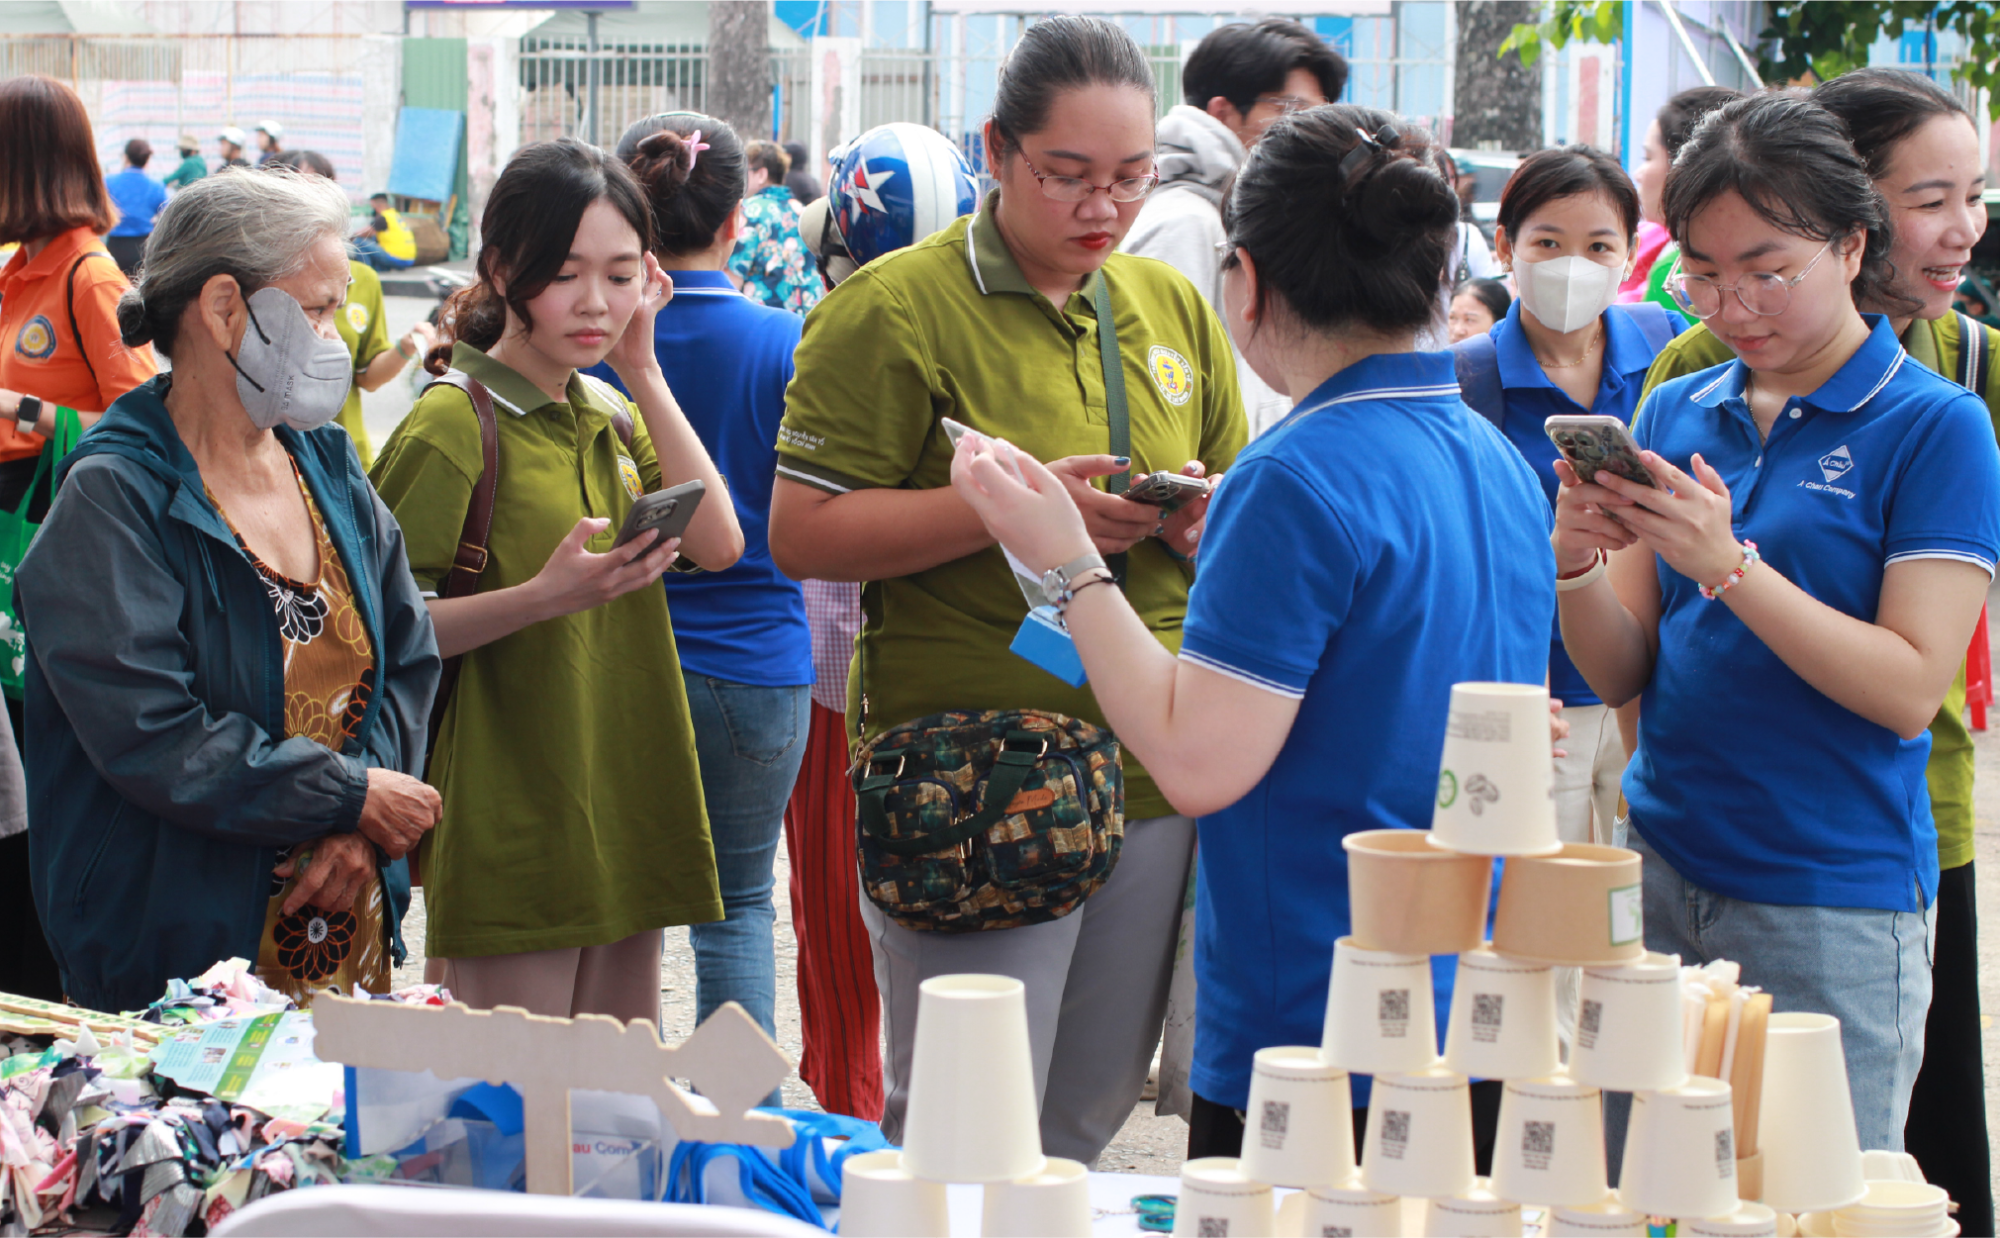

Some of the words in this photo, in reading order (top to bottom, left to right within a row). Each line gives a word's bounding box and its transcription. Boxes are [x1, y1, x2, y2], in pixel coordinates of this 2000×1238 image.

[1823, 484, 1855, 499] Company
[573, 1143, 591, 1154] au
[596, 1141, 631, 1155] Com
